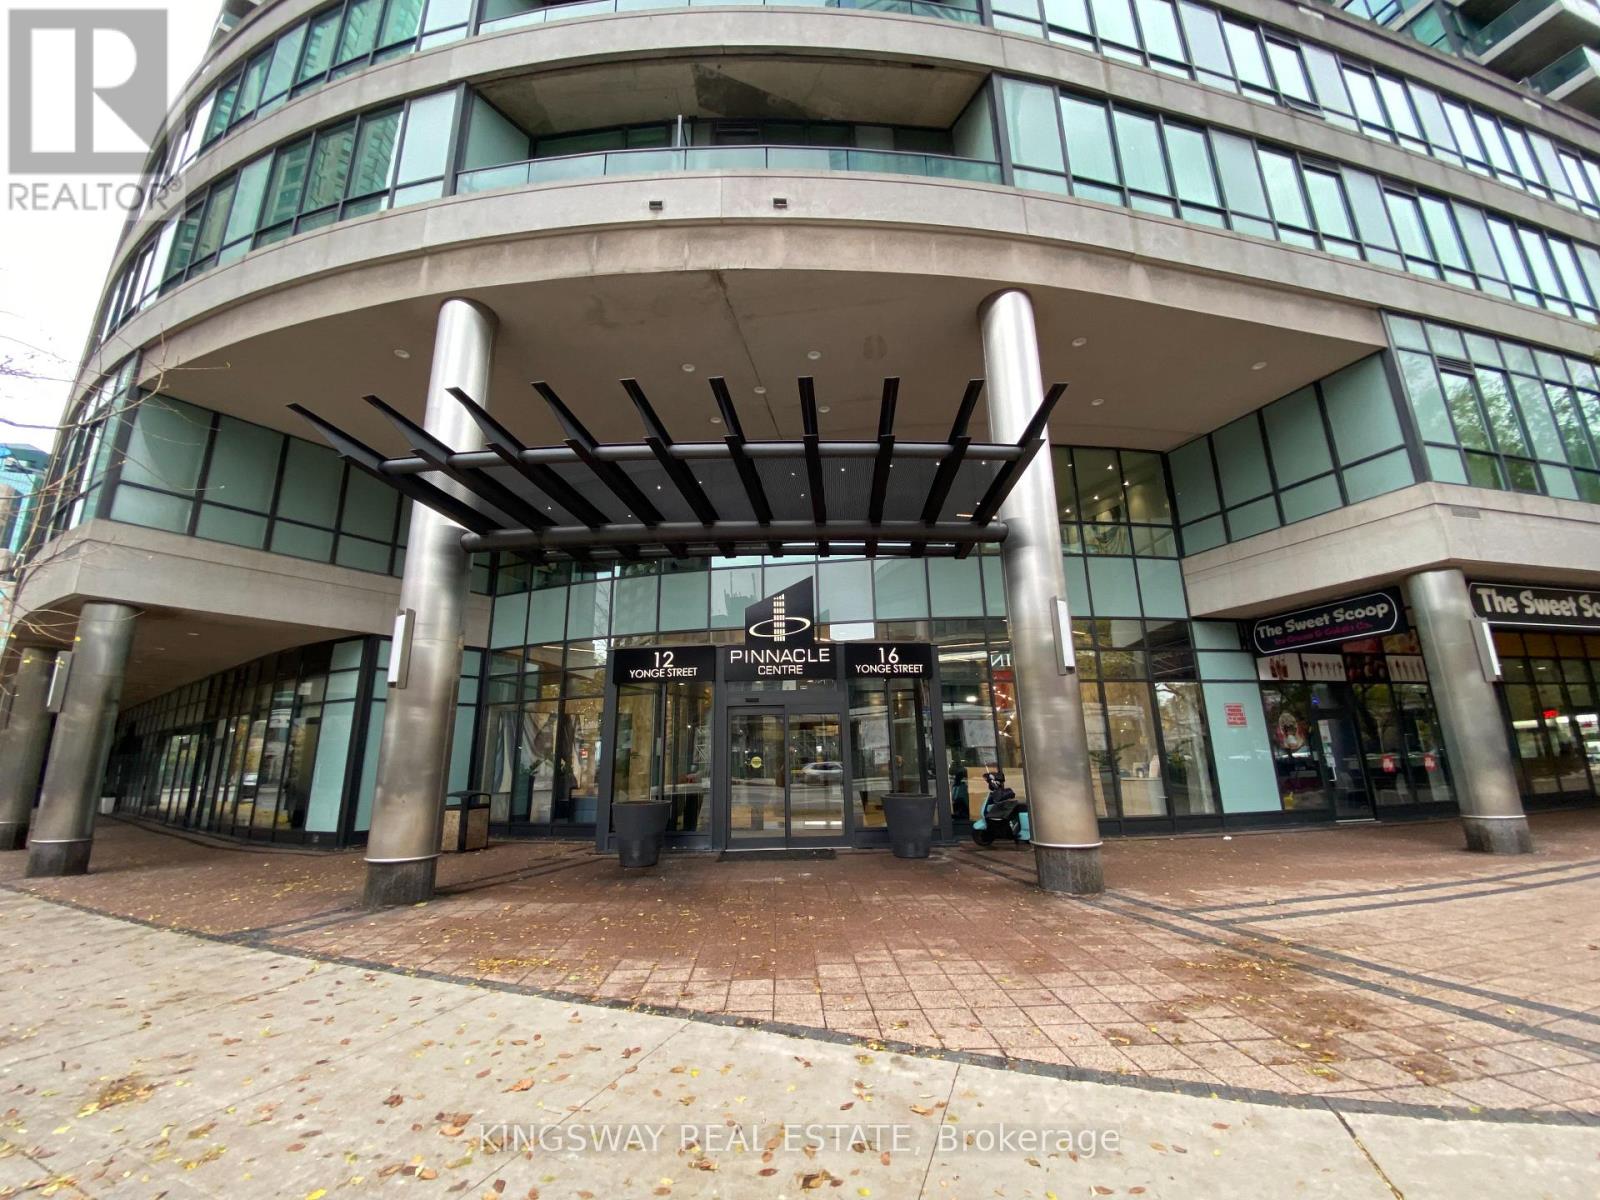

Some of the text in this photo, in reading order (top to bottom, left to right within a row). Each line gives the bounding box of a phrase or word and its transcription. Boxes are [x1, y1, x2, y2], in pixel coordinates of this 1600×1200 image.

[1476, 587, 1519, 613] The
[1520, 590, 1578, 616] Sweet
[1257, 624, 1283, 639] The
[1285, 613, 1331, 633] Sweet
[1332, 602, 1389, 623] Scoop
[654, 651, 674, 668] 12
[730, 648, 831, 664] PINNACLE
[878, 647, 899, 664] 16
[629, 667, 698, 679] YONGE STREET
[757, 664, 803, 675] CENTRE
[855, 664, 924, 673] YONGE STREET
